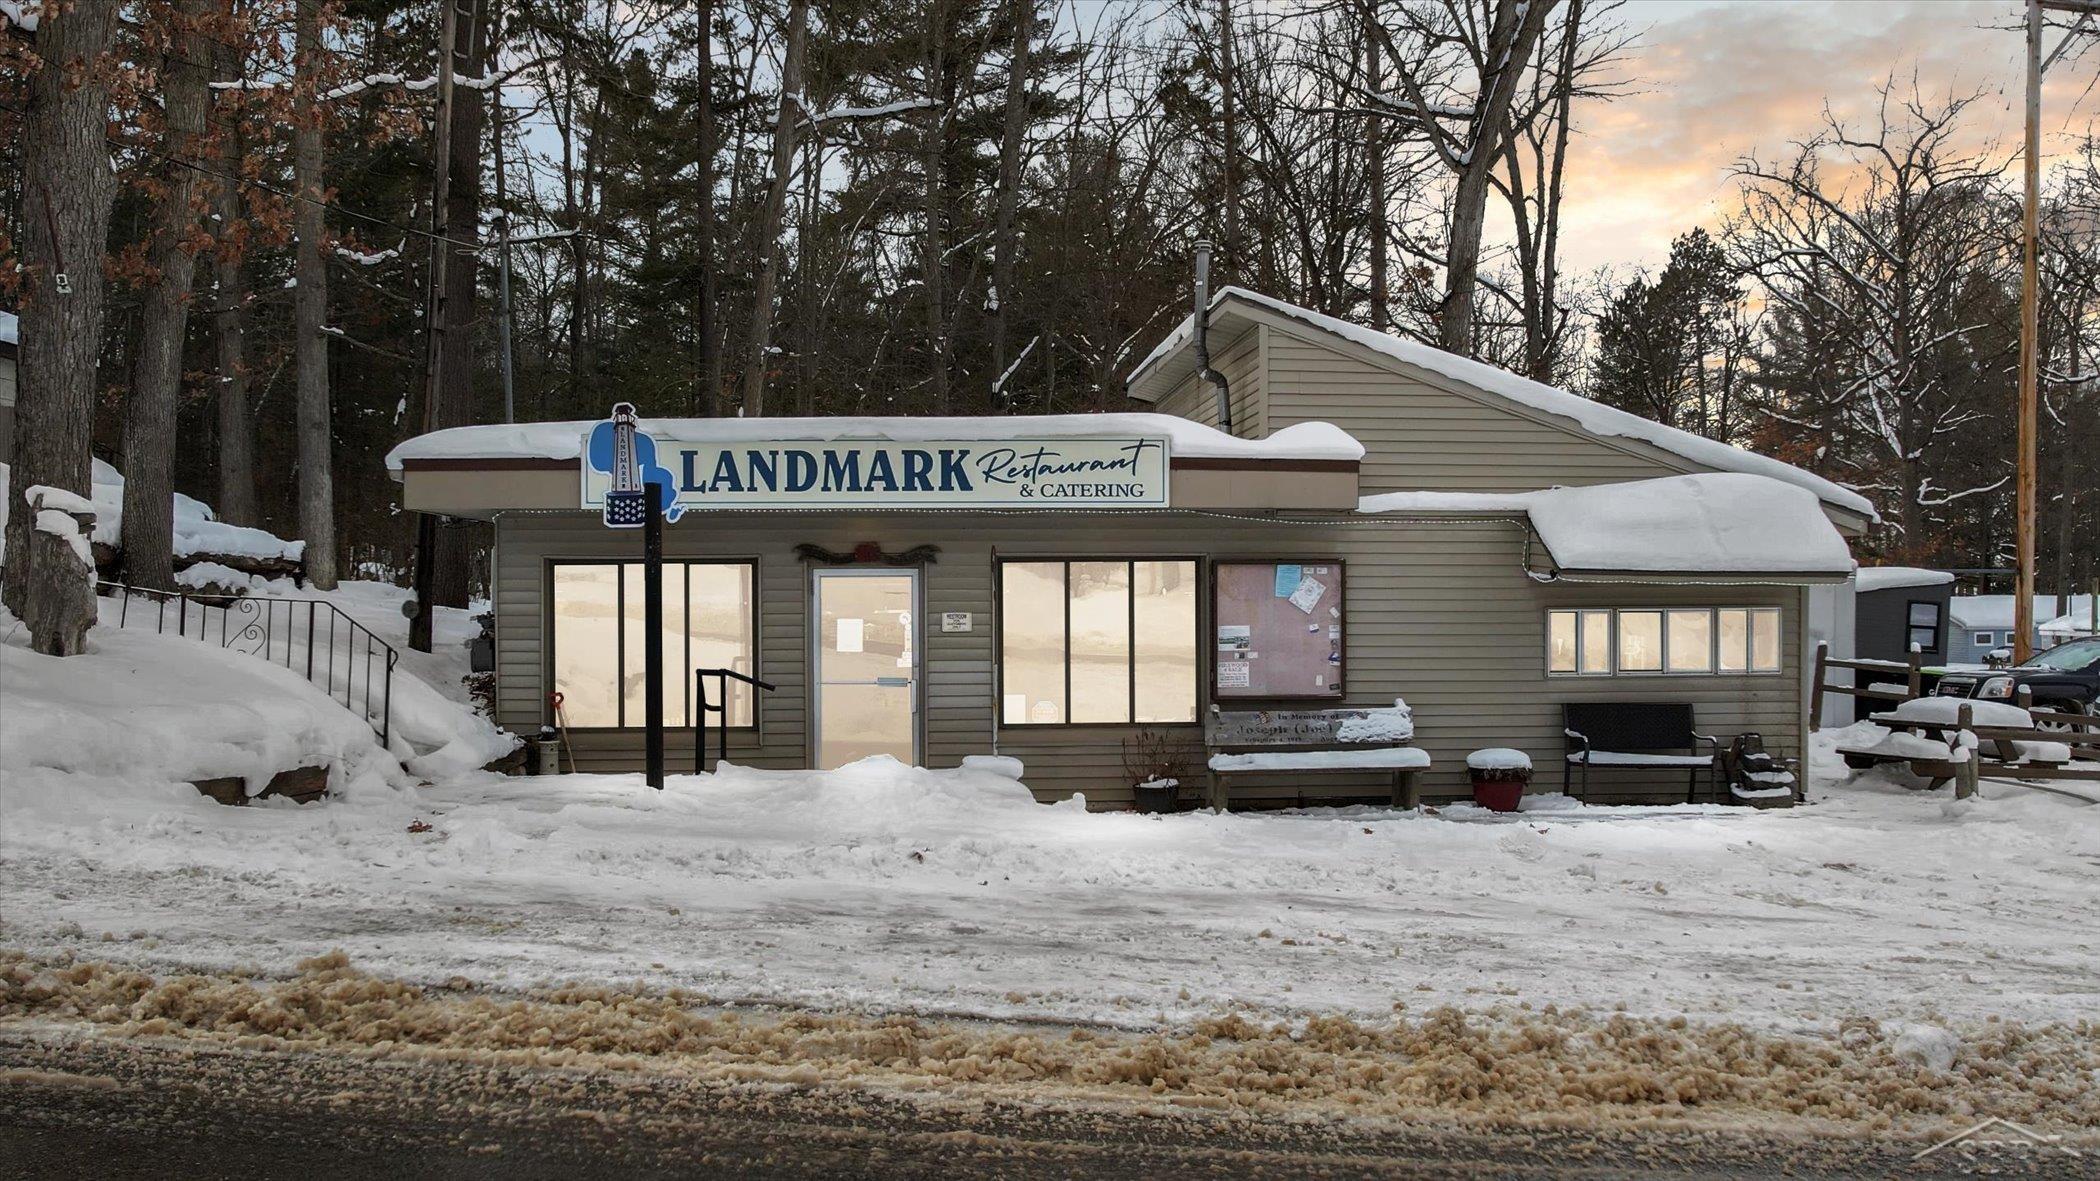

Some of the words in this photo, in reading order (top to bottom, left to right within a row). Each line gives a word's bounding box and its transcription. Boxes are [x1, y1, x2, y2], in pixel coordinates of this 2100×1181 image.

[619, 431, 628, 483] LANDMARK
[680, 449, 974, 494] LANDMARK
[976, 438, 1160, 485] Restaurant
[1019, 483, 1034, 498] &
[1040, 483, 1145, 498] CATERING
[1291, 713, 1327, 721] Memory
